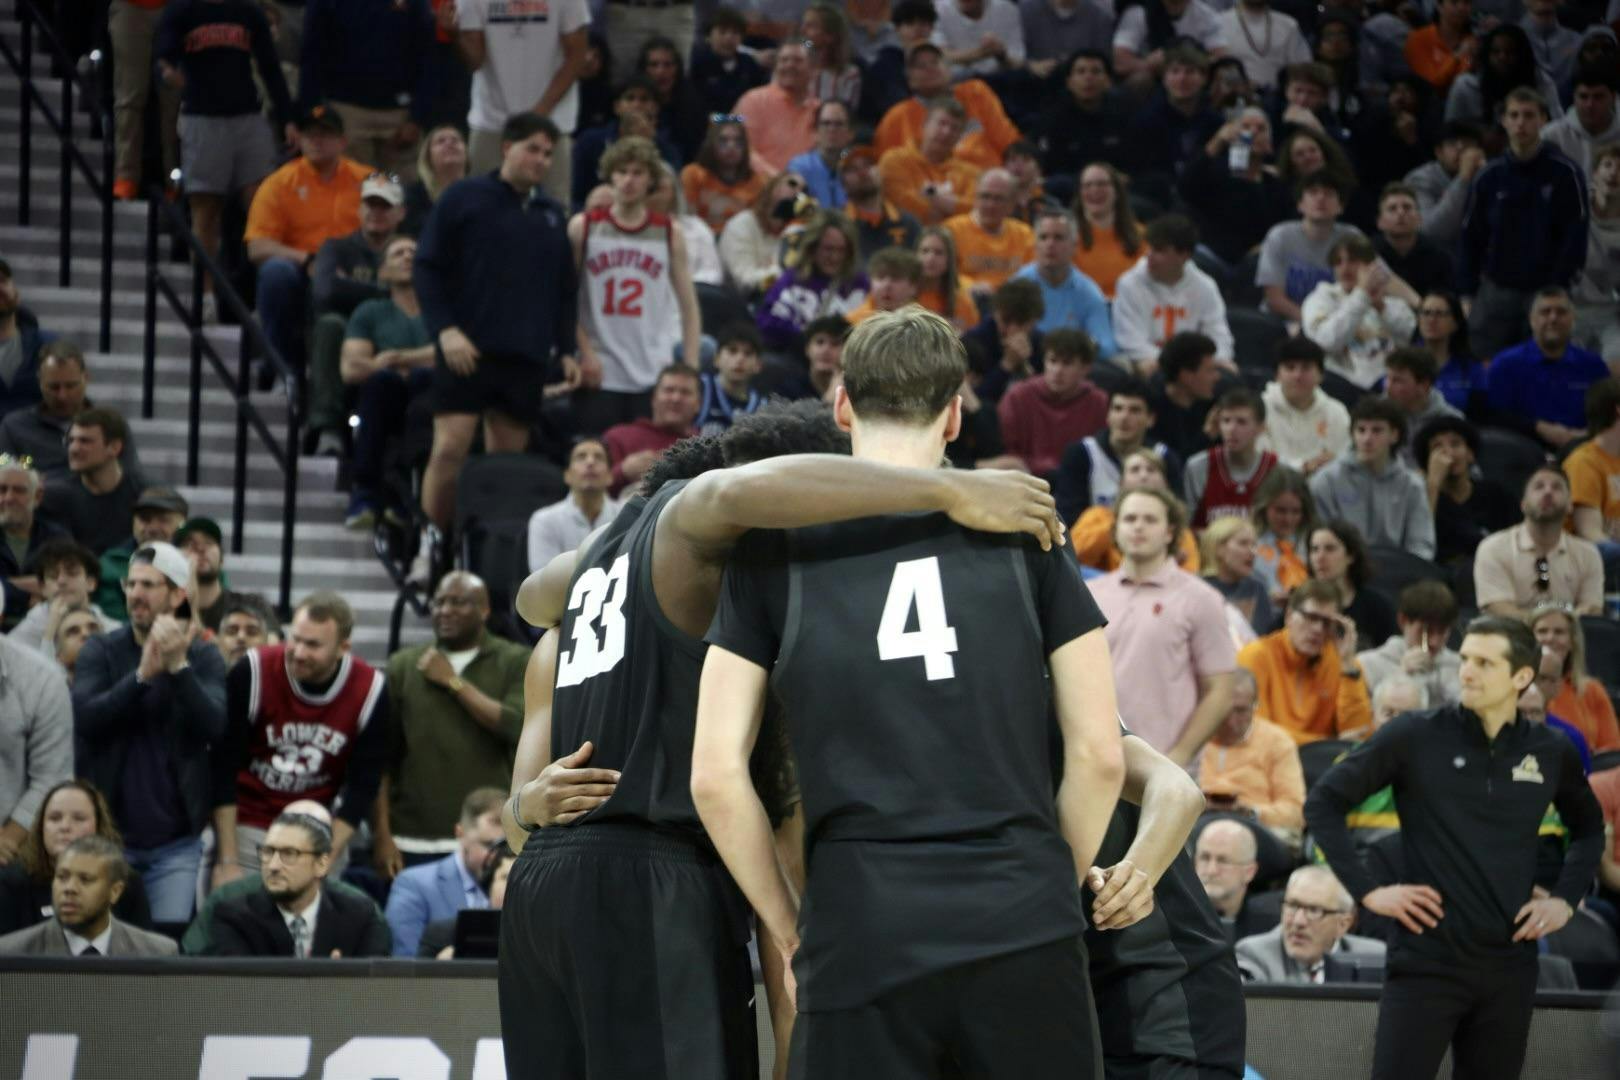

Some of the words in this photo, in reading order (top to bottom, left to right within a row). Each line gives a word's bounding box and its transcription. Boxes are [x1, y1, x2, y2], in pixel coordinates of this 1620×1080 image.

[602, 278, 644, 317] 12
[555, 552, 630, 689] 33
[876, 556, 959, 682] 4
[265, 720, 347, 756] LOWER
[271, 743, 324, 775] 33
